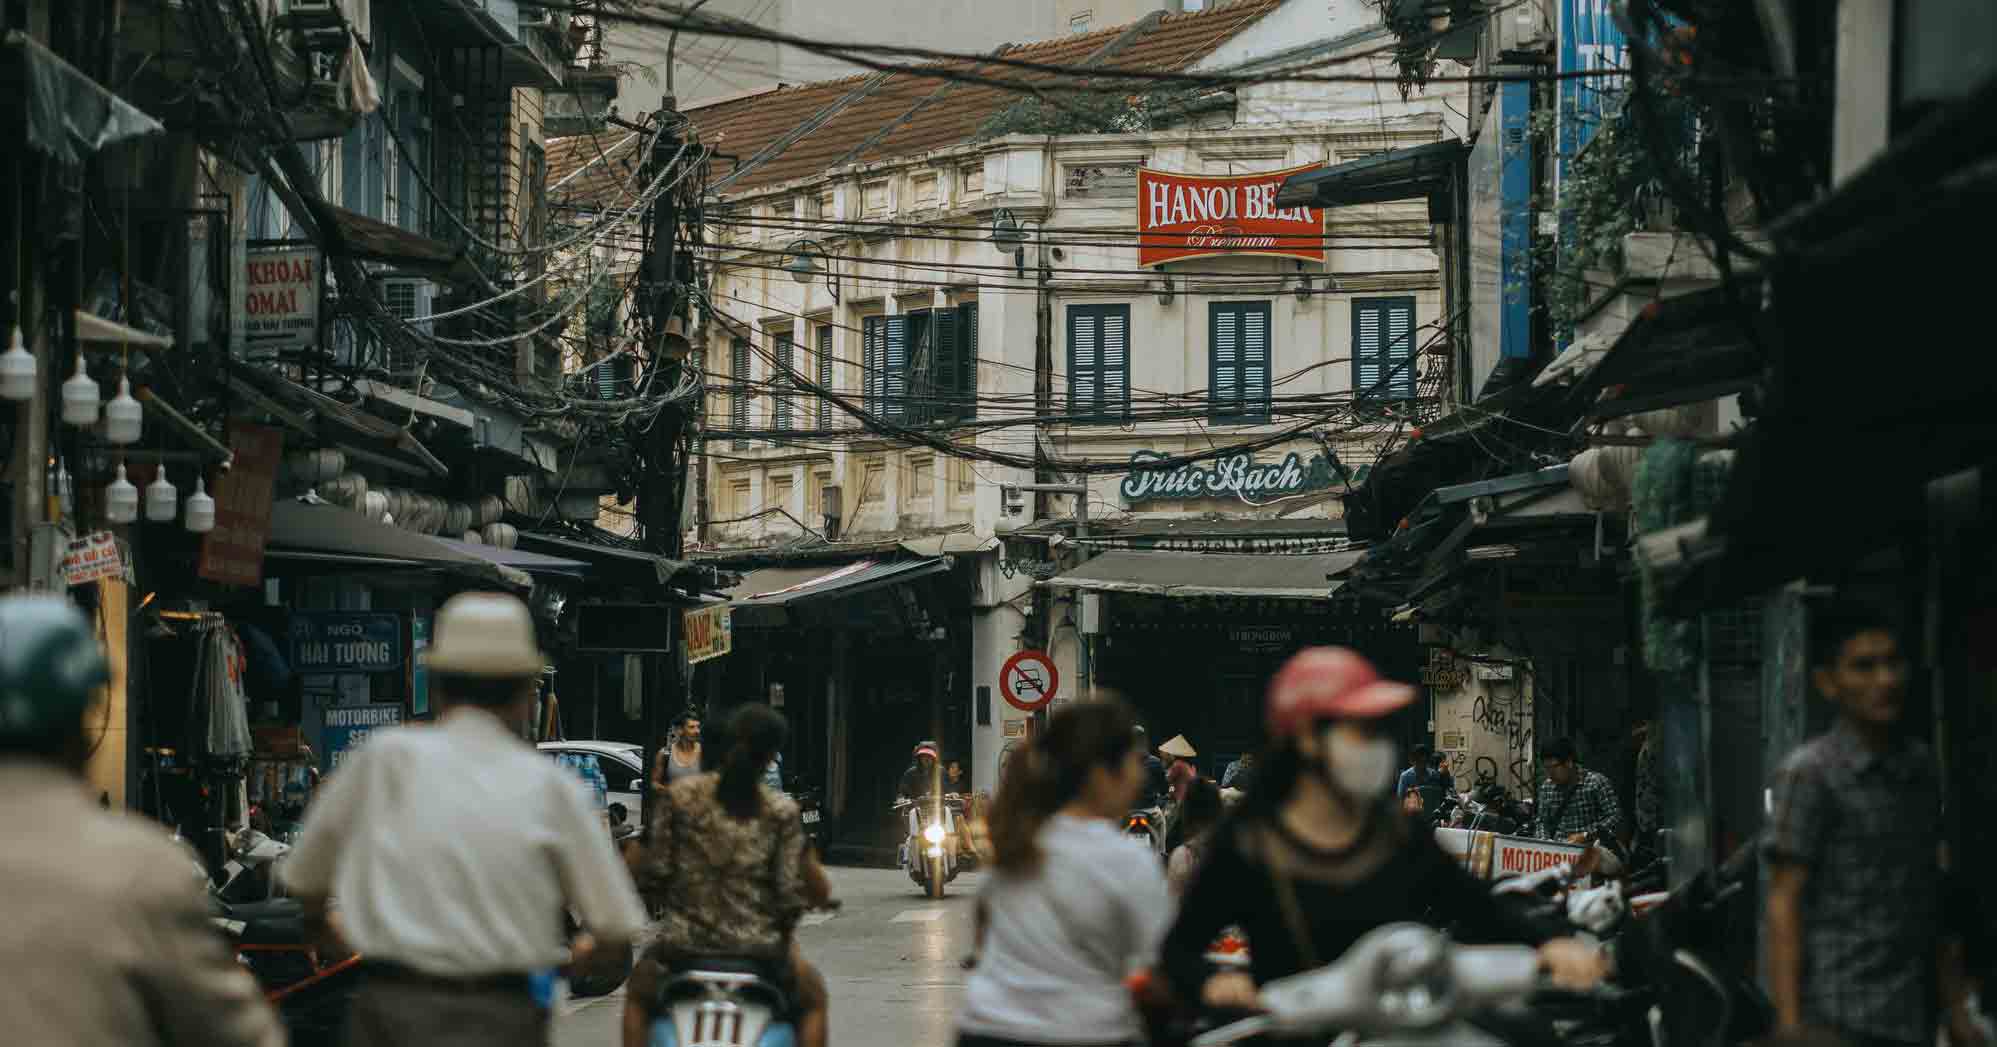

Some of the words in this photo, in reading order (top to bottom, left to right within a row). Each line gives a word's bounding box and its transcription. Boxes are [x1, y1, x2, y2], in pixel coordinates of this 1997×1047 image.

[1147, 180, 1238, 228] HANOI
[1243, 183, 1315, 224] BE
[1124, 453, 1203, 497] Trúc
[1206, 453, 1303, 496] Bạch
[325, 707, 399, 727] MOTORBIKE
